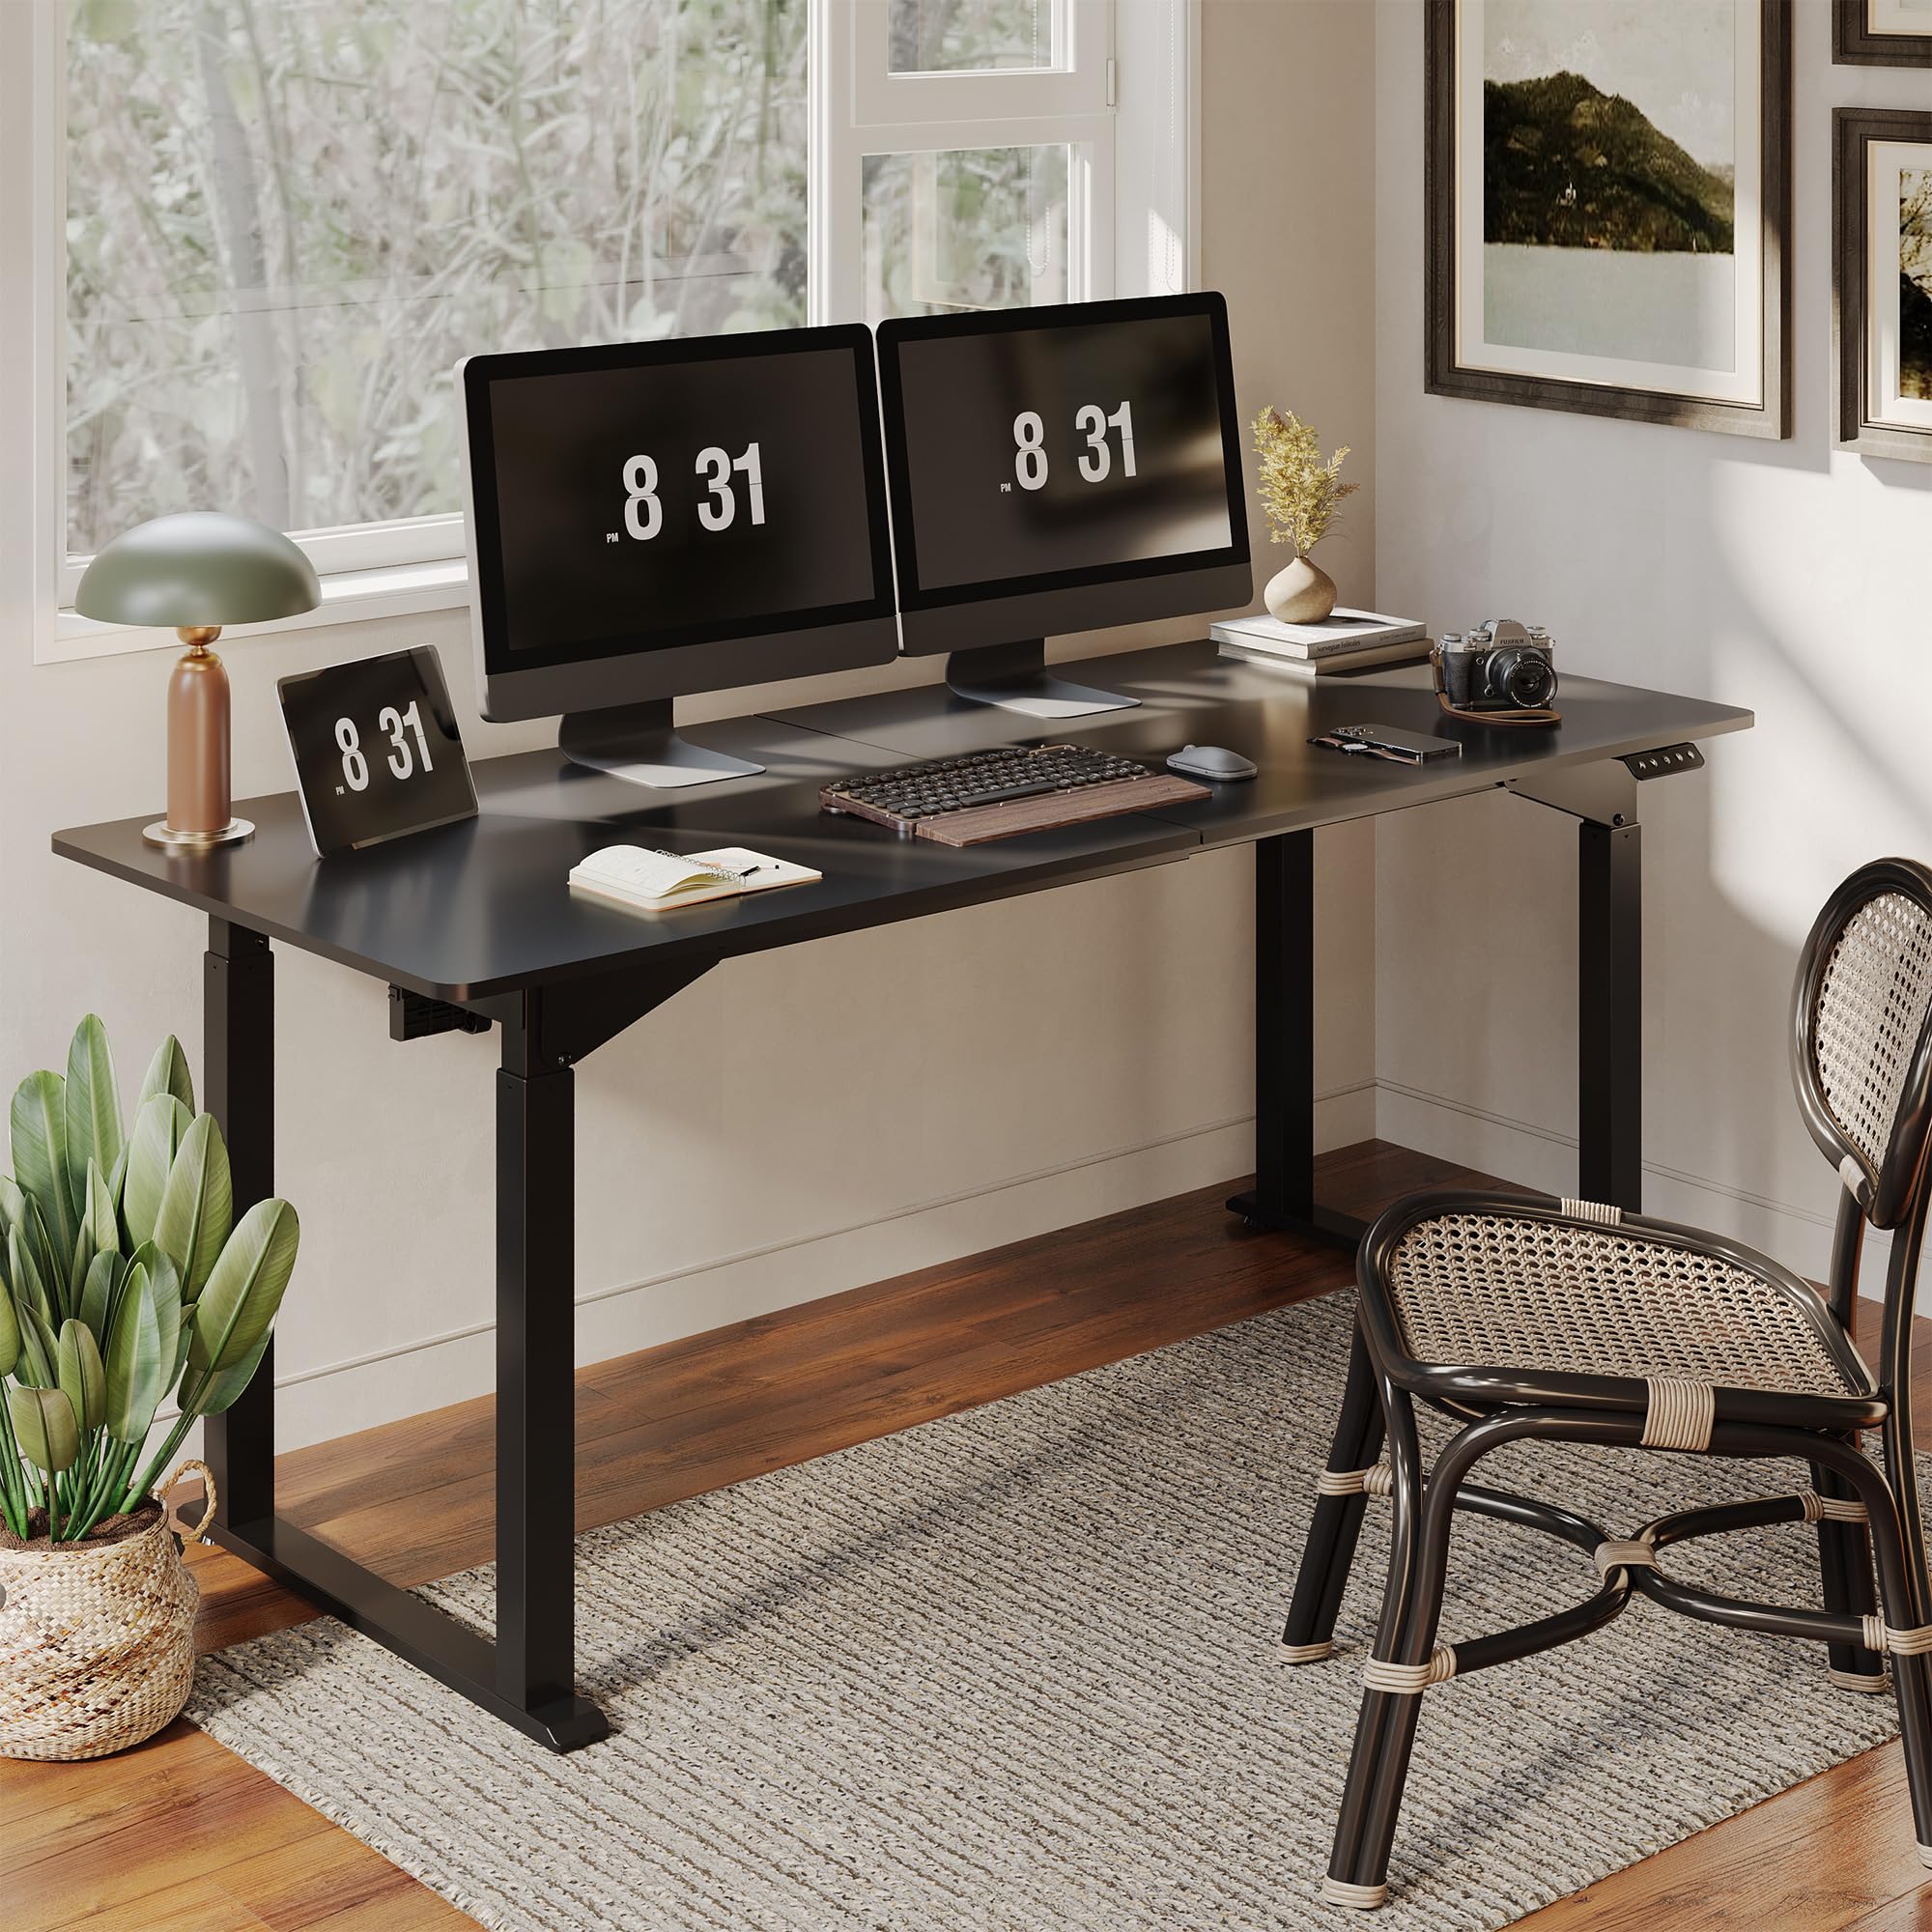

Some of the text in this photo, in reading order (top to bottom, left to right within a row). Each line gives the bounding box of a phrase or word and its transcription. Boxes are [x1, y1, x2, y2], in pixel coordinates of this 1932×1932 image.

[607, 441, 766, 544] PM 8 31
[1000, 400, 1137, 493] PM 8 31
[334, 700, 434, 796] PM 8 31
